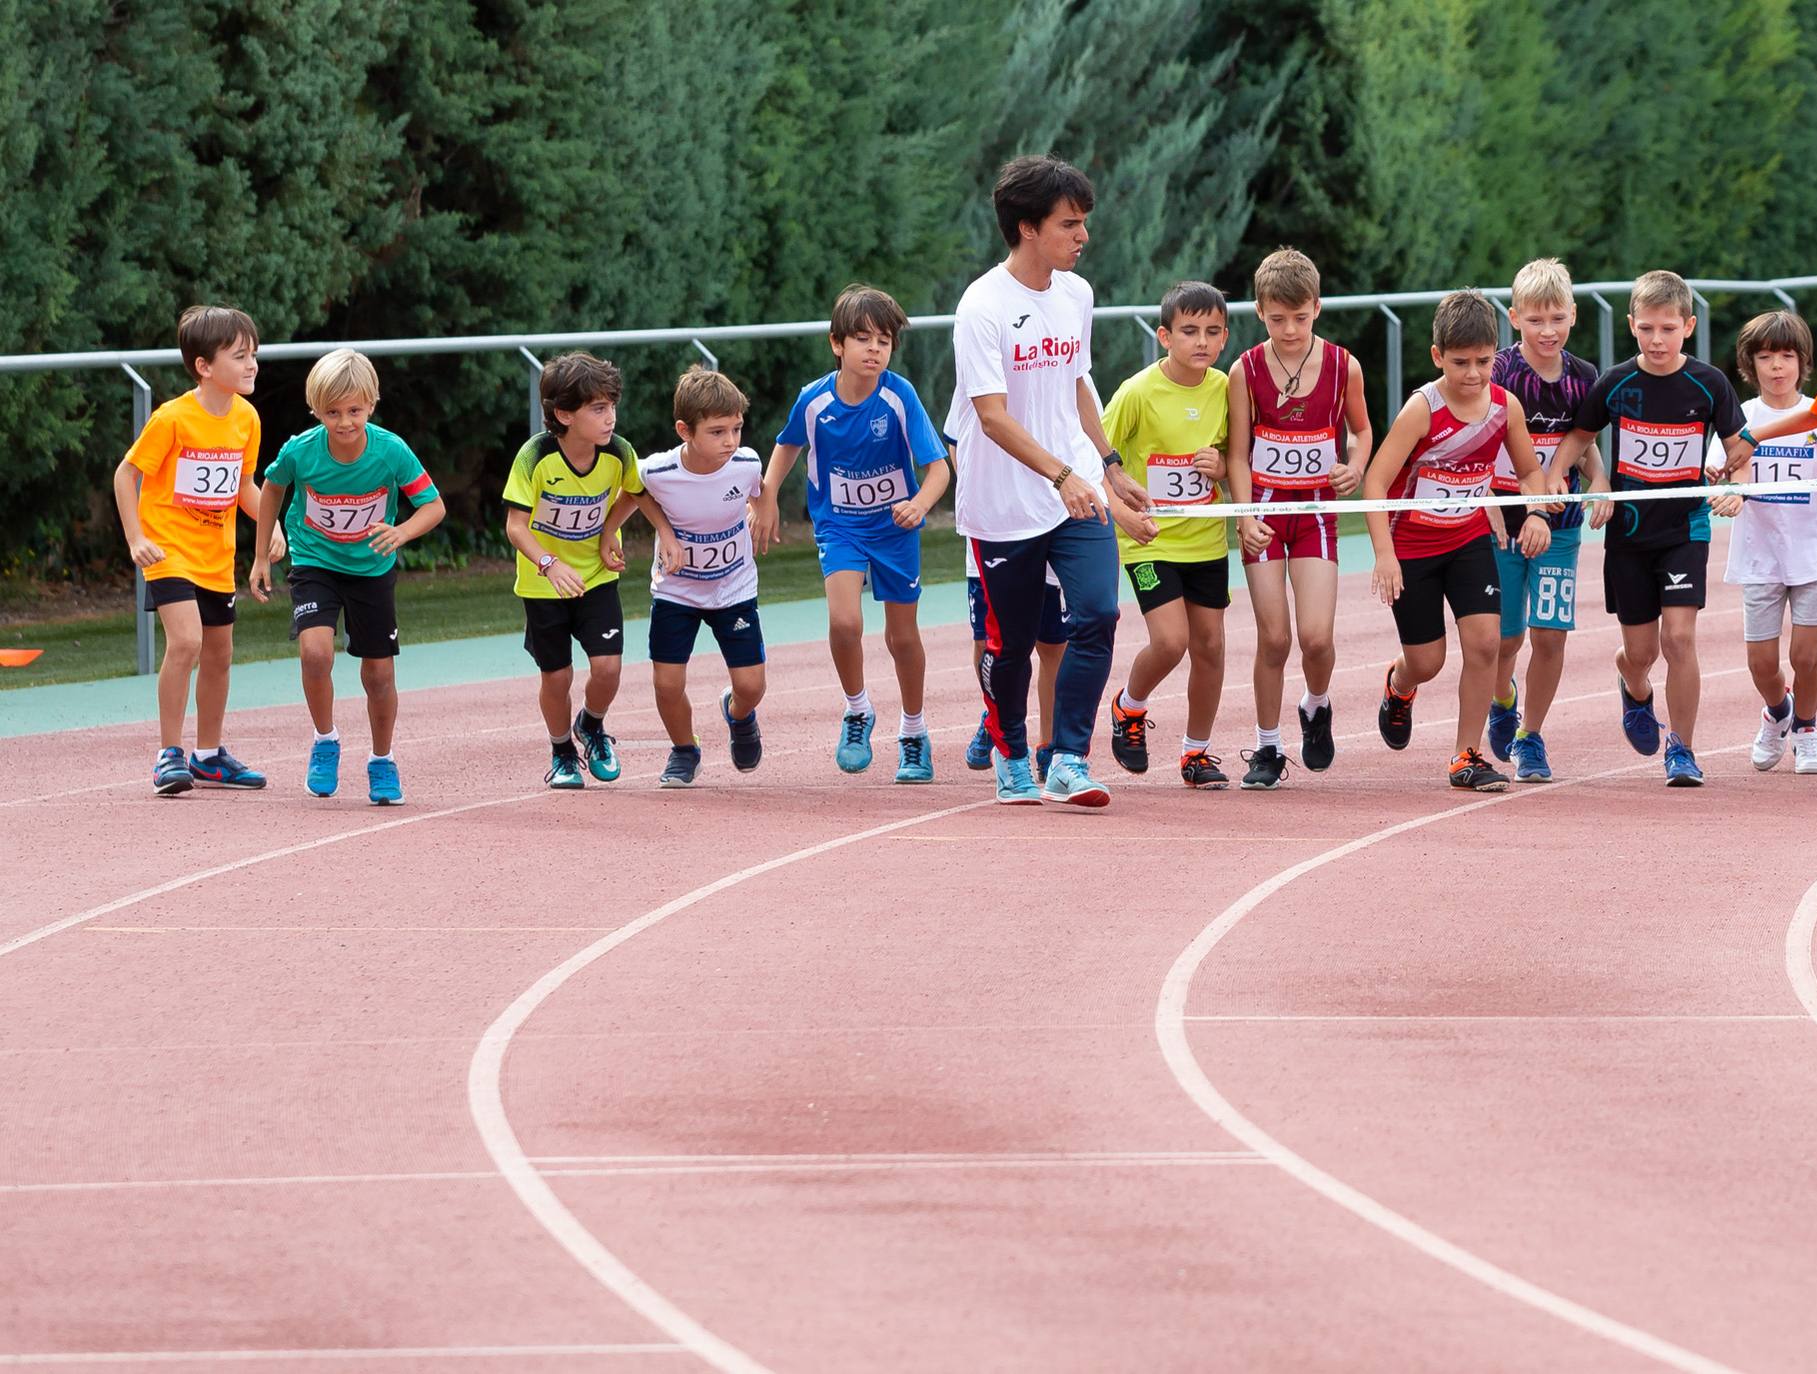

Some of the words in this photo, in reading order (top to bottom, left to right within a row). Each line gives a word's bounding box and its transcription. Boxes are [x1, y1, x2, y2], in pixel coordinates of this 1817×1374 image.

[1014, 343, 1038, 361] La
[1042, 335, 1080, 365] Rioja
[1262, 430, 1268, 439] LA
[1269, 432, 1290, 441] RIOJA
[1292, 432, 1328, 442] ATLETISMO
[1627, 423, 1636, 432] LA
[1637, 426, 1658, 435] RIOJA
[1660, 426, 1696, 436] ATLETISMO
[185, 451, 196, 459] LA
[197, 452, 218, 460] RIOJA
[1265, 447, 1322, 475] 298
[1633, 439, 1689, 467] 297
[1760, 446, 1810, 458] HEMAFIX
[193, 466, 239, 493] 328
[847, 464, 896, 479] HEMAFIX
[1427, 472, 1437, 480] LA
[1438, 474, 1460, 484] RIOJA
[319, 497, 342, 505] RIOJA
[344, 491, 382, 505] ATLETISMO
[840, 478, 895, 506] 109
[319, 504, 377, 530] 377
[546, 507, 602, 531] 119
[694, 524, 741, 543] HEMAFIX
[684, 541, 738, 570] 120
[1536, 576, 1574, 623] 89
